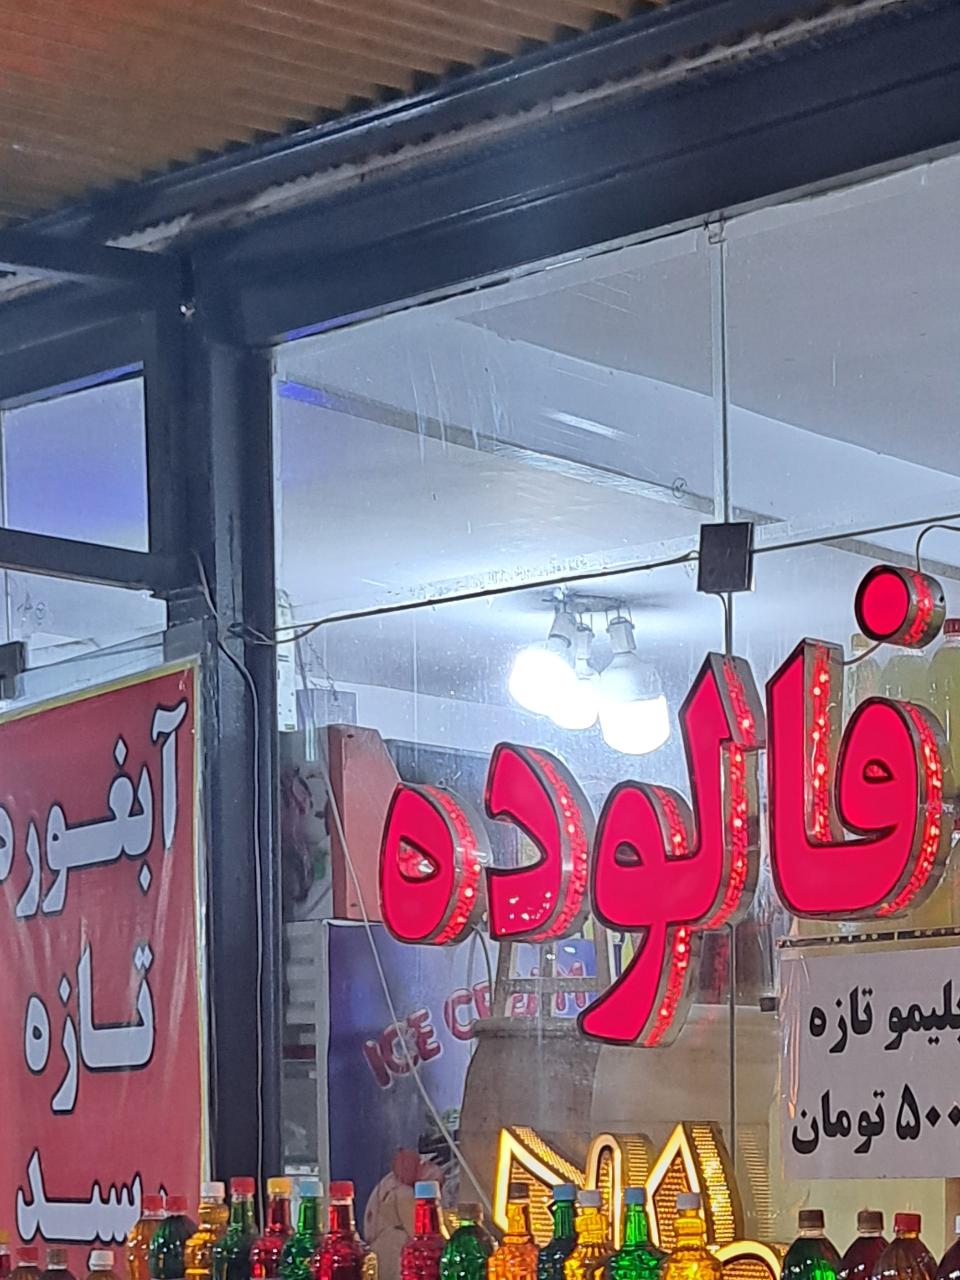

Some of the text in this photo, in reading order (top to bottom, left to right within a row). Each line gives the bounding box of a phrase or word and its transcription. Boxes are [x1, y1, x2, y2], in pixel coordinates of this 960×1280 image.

[379, 563, 948, 1047] فالوده
[24, 940, 155, 1115] تازه
[364, 1008, 441, 1088] ICE
[810, 986, 873, 1053] تازه
[792, 1089, 885, 1154] تومان
[16, 1146, 168, 1246] سید
